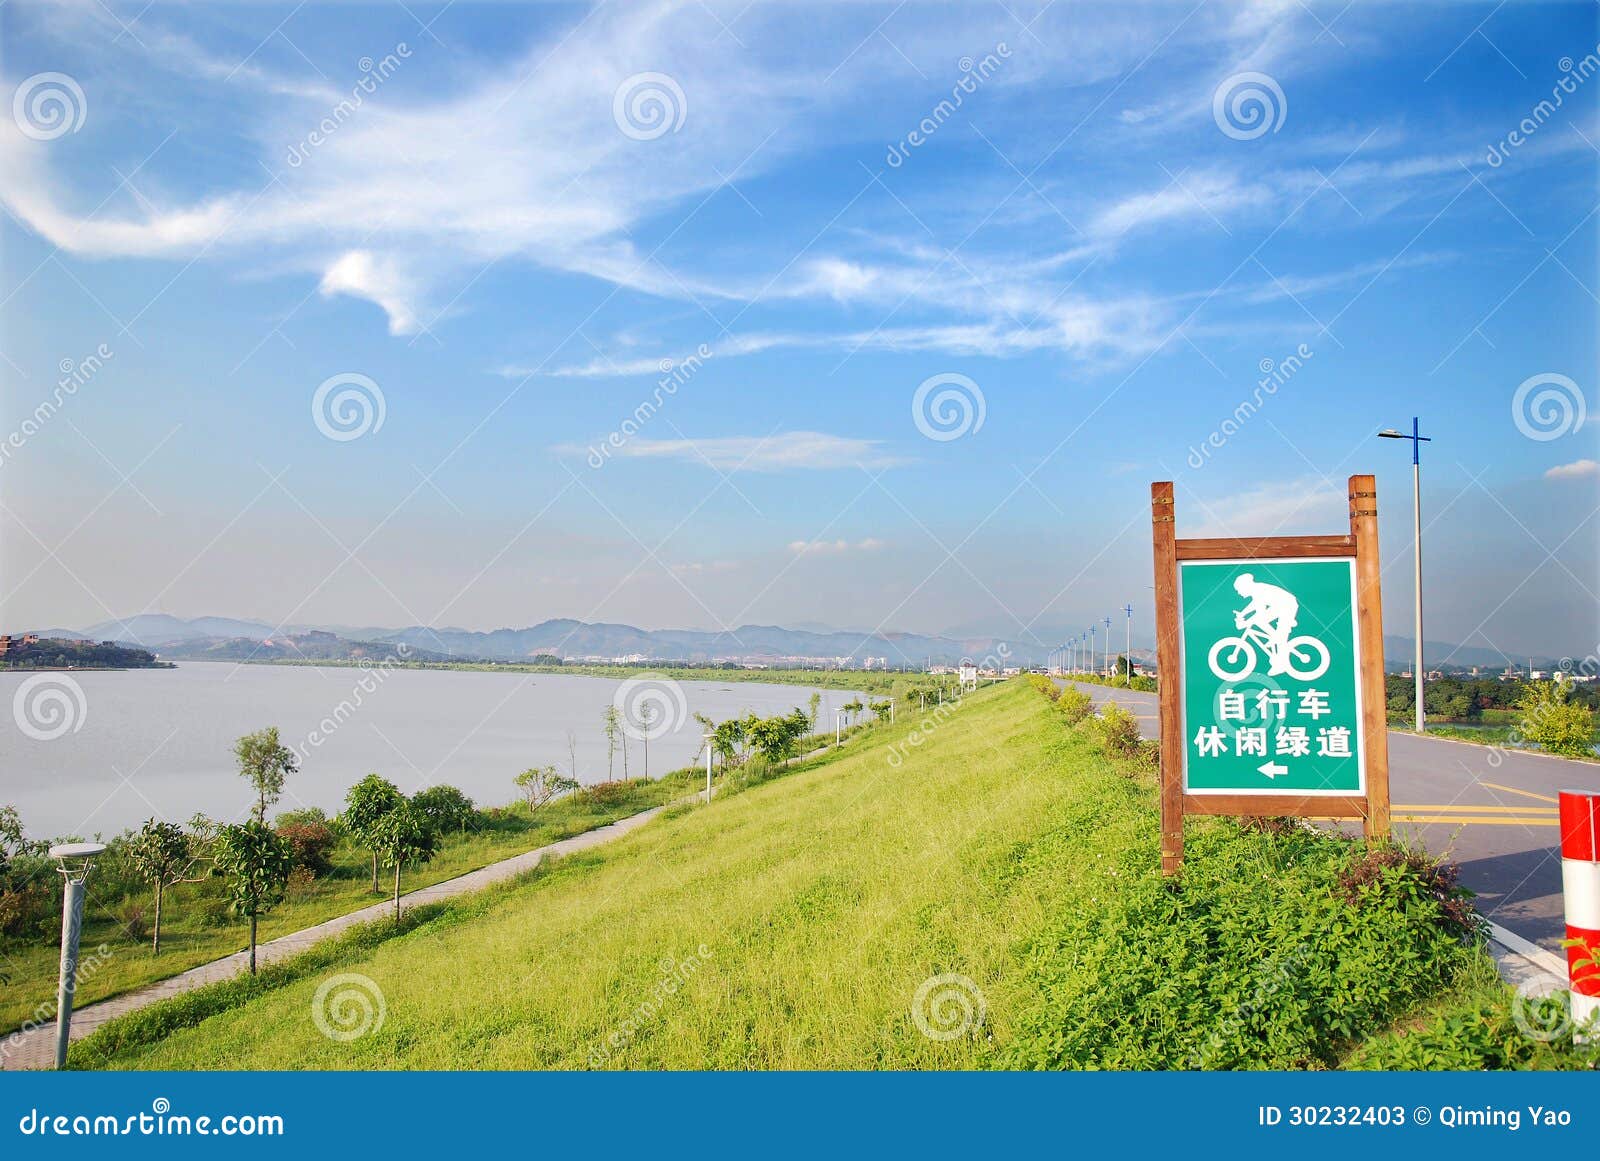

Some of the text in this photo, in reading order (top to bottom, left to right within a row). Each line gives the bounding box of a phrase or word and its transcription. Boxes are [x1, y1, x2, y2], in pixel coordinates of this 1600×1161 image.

[1219, 688, 1331, 720] 自行车
[1194, 725, 1352, 758] 休闲绿道
